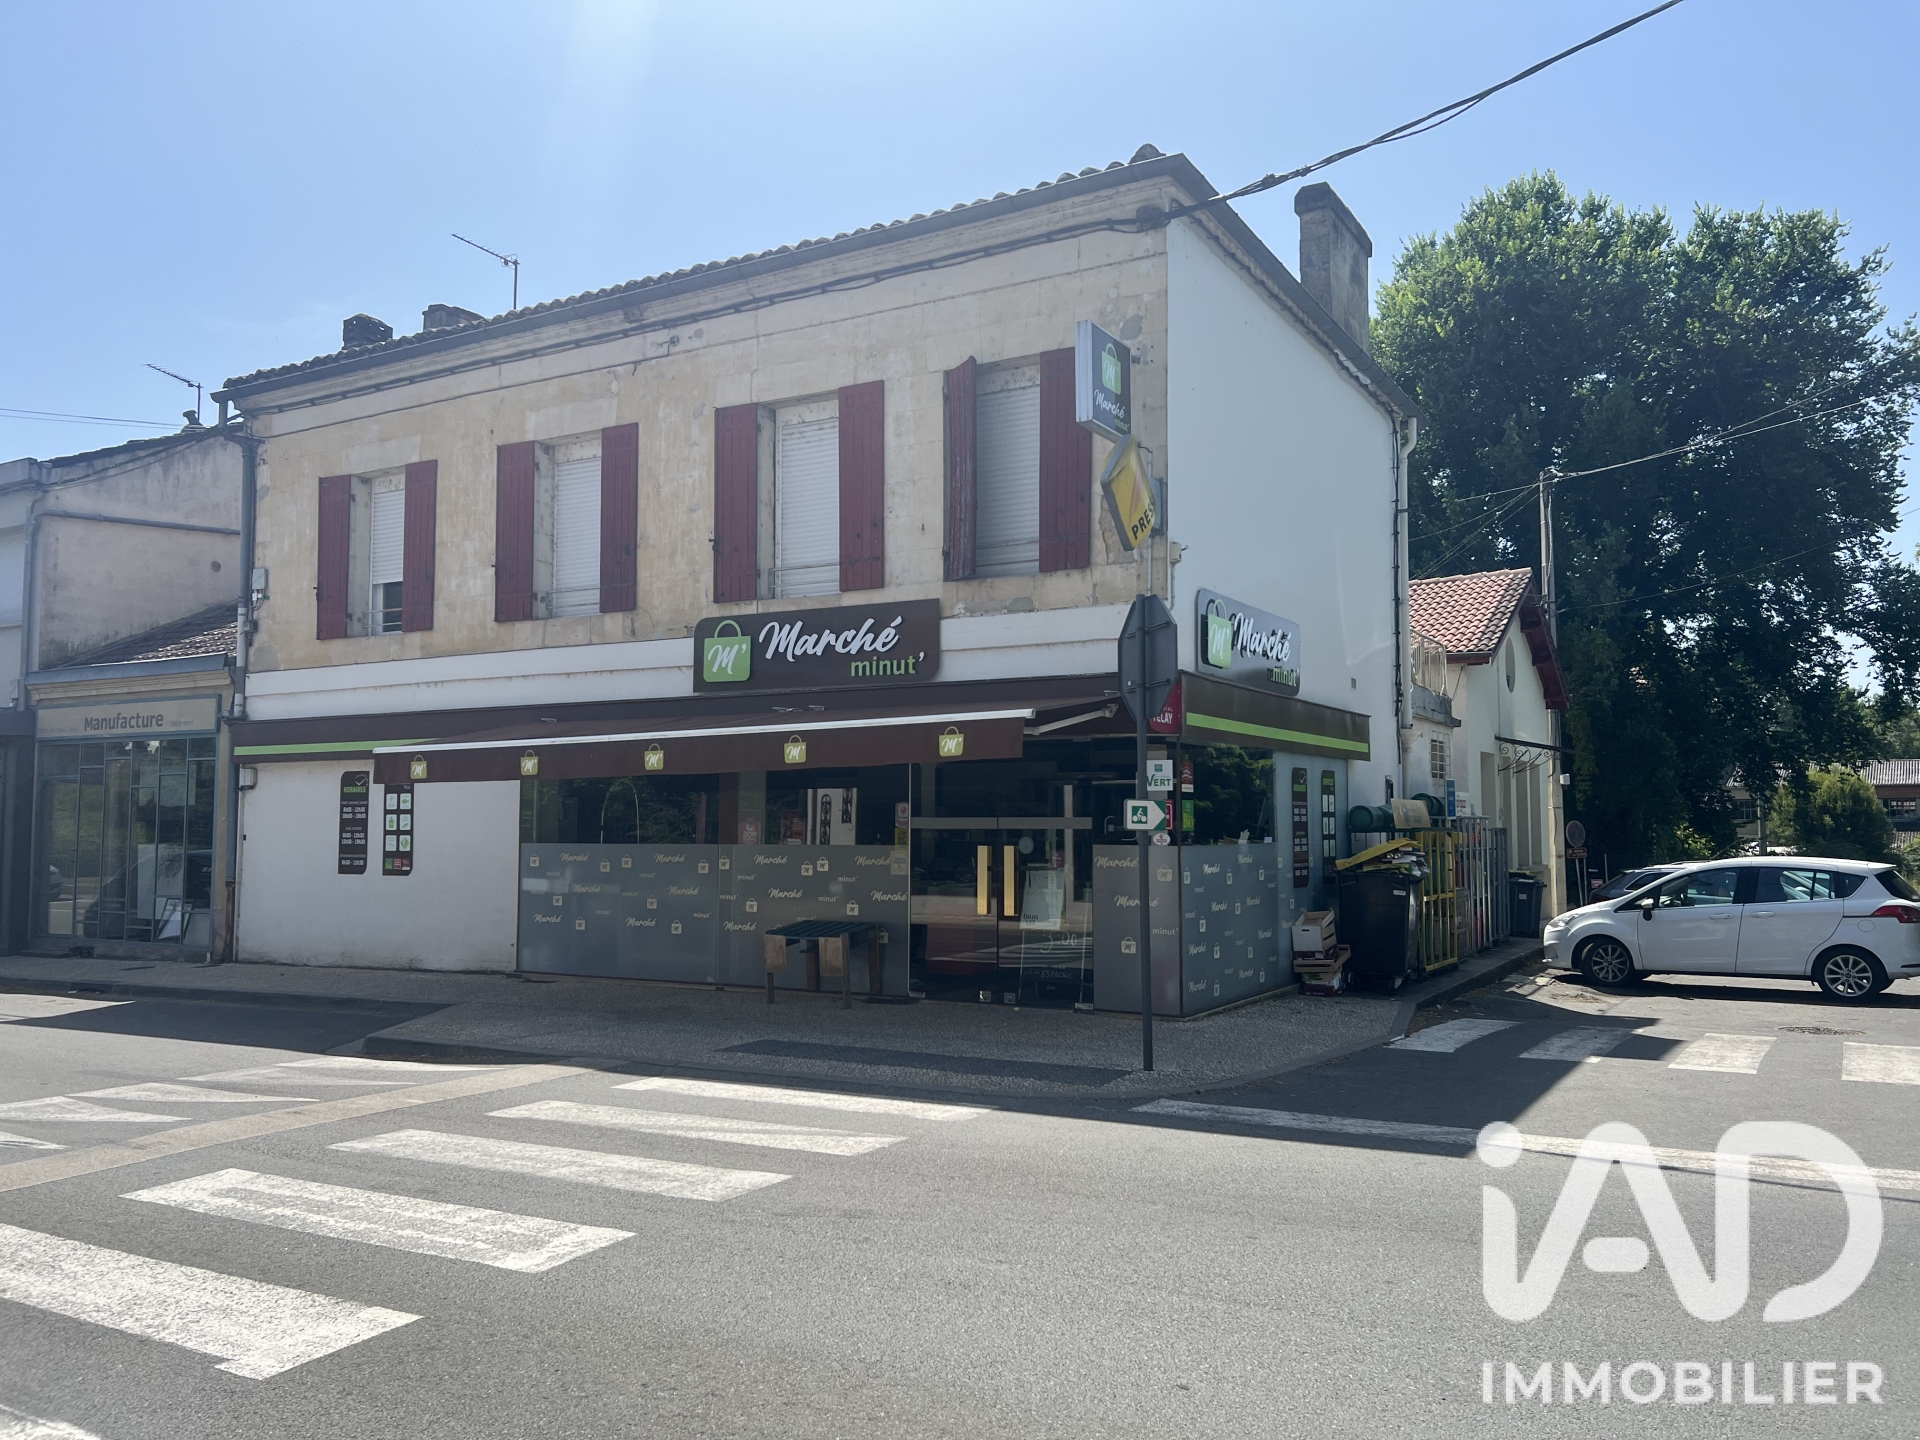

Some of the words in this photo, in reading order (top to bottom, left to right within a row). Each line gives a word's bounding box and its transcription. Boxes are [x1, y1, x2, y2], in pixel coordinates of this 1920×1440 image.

[1094, 389, 1125, 419] Marché
[760, 615, 903, 662] Marché
[1234, 612, 1292, 662] Marché
[850, 651, 926, 677] minut'
[84, 712, 164, 731] Manufacture
[654, 853, 687, 863] Marché
[754, 854, 789, 865] Marché
[1095, 856, 1139, 868] Marché
[768, 888, 803, 899] Marché
[871, 890, 909, 902] Marché
[626, 917, 657, 927] Marché
[723, 921, 757, 931] Marché
[1152, 926, 1179, 936] minut'
